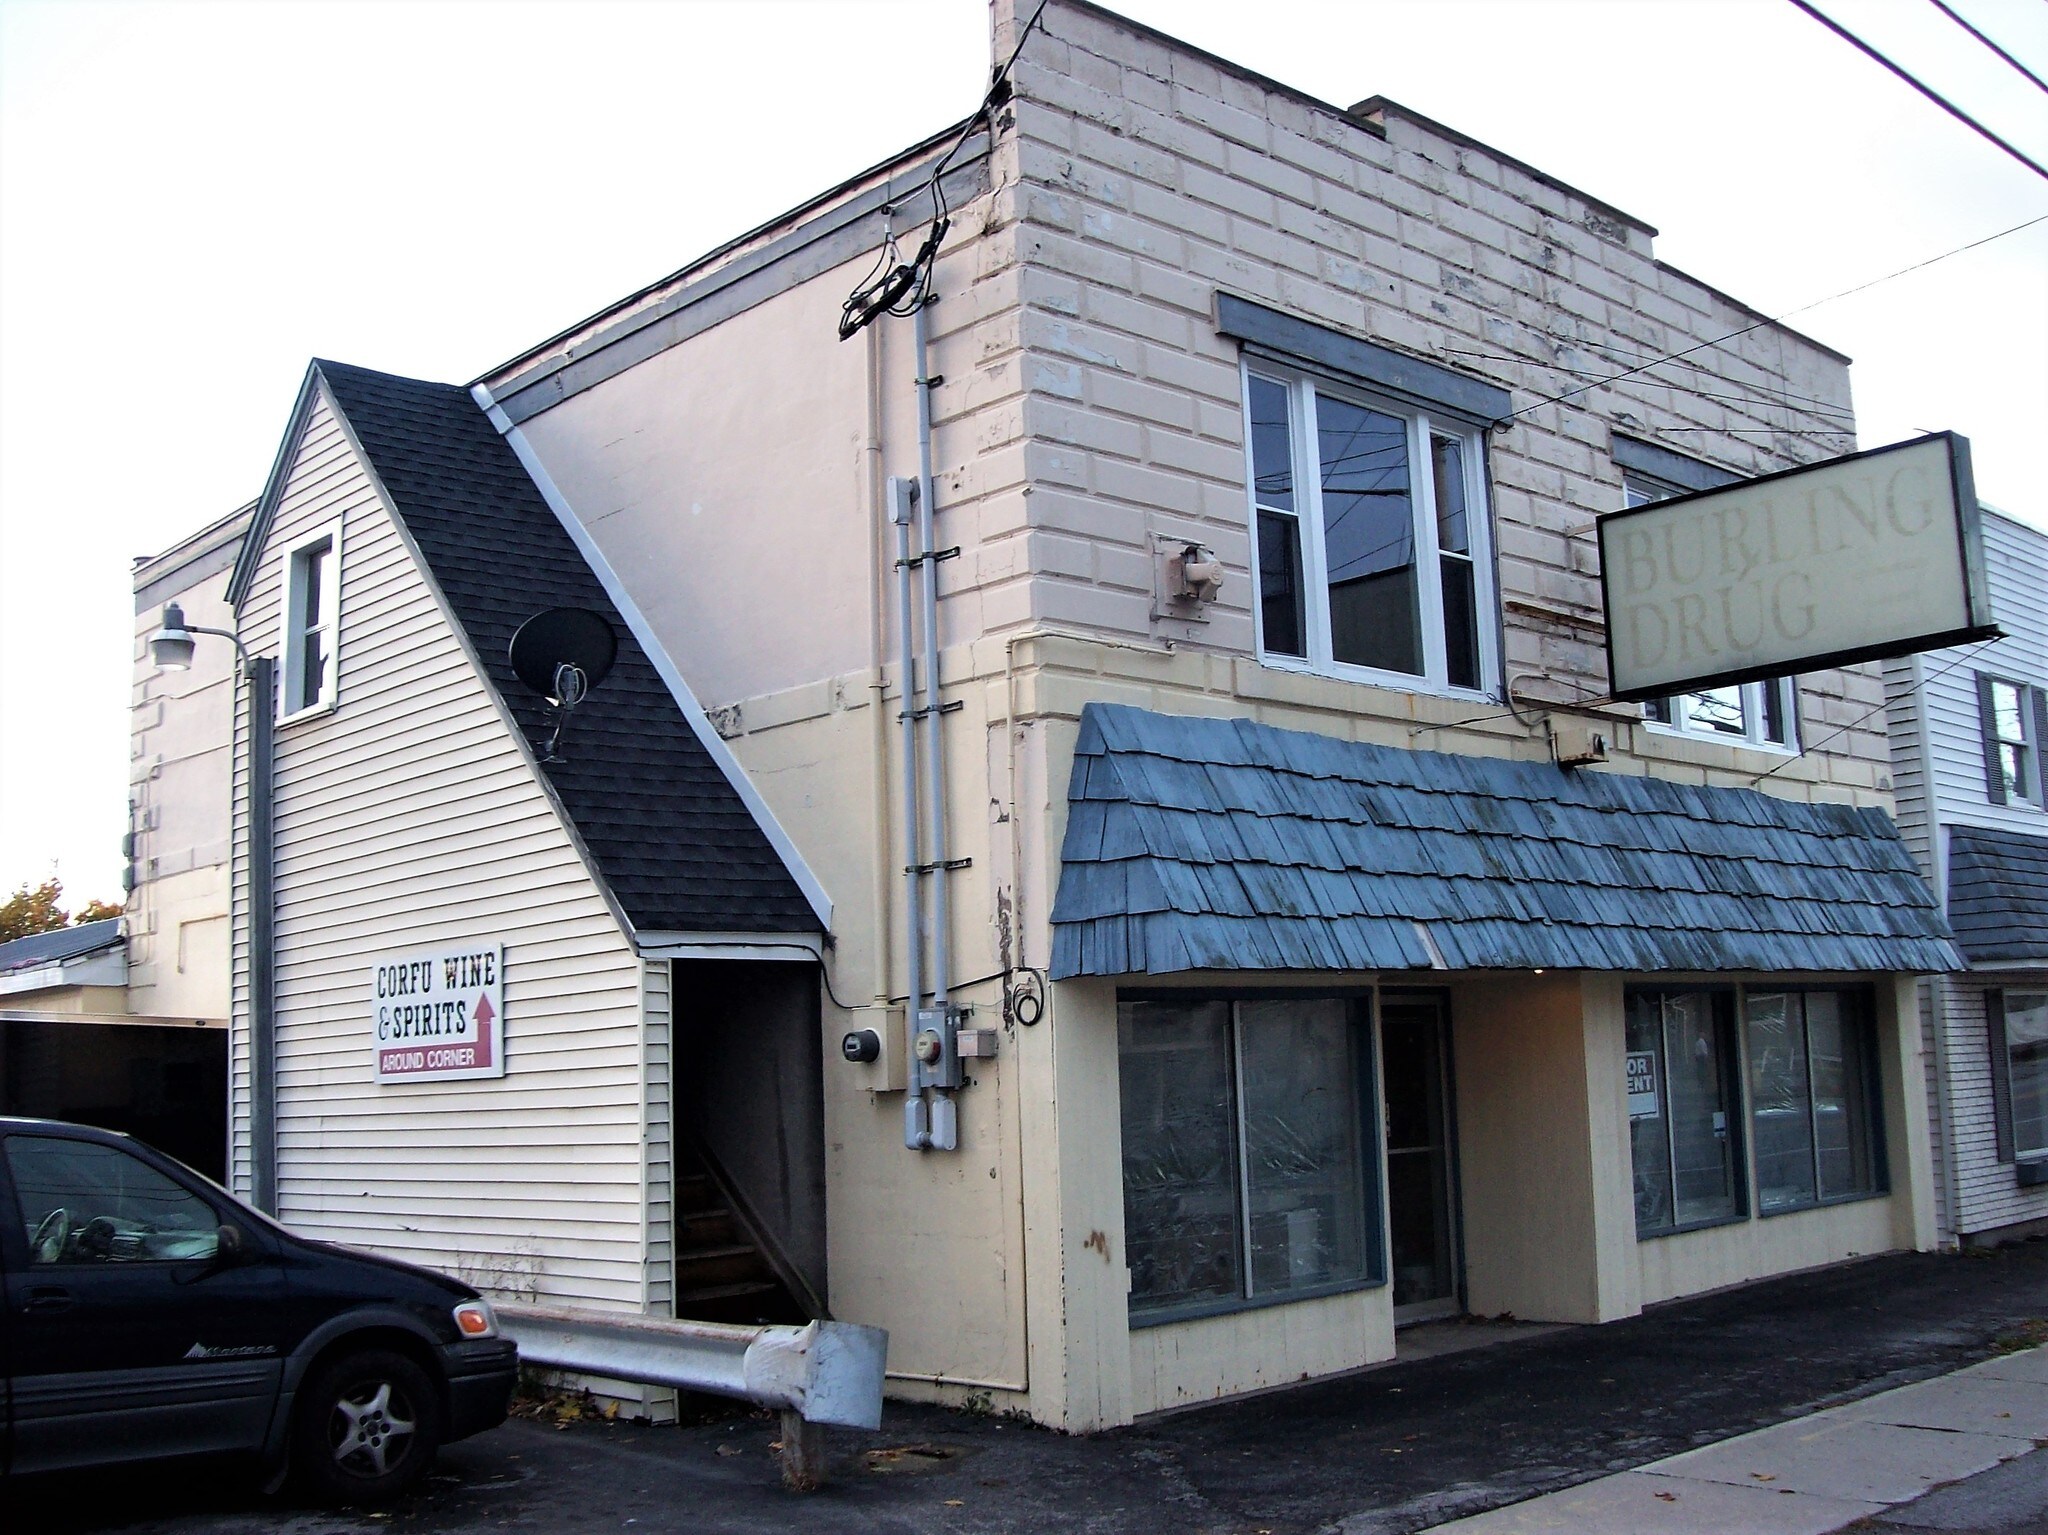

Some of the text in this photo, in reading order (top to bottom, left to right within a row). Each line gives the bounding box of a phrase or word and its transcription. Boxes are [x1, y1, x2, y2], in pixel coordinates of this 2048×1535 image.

[1619, 465, 1934, 596] BURLING
[1628, 570, 1815, 669] DRUG
[378, 951, 495, 998] CORFU WINE
[392, 1000, 466, 1038] SPIRITS
[382, 1048, 475, 1071] AROUND CORNER
[1626, 1058, 1648, 1075] OR
[1627, 1074, 1652, 1092] ENT
